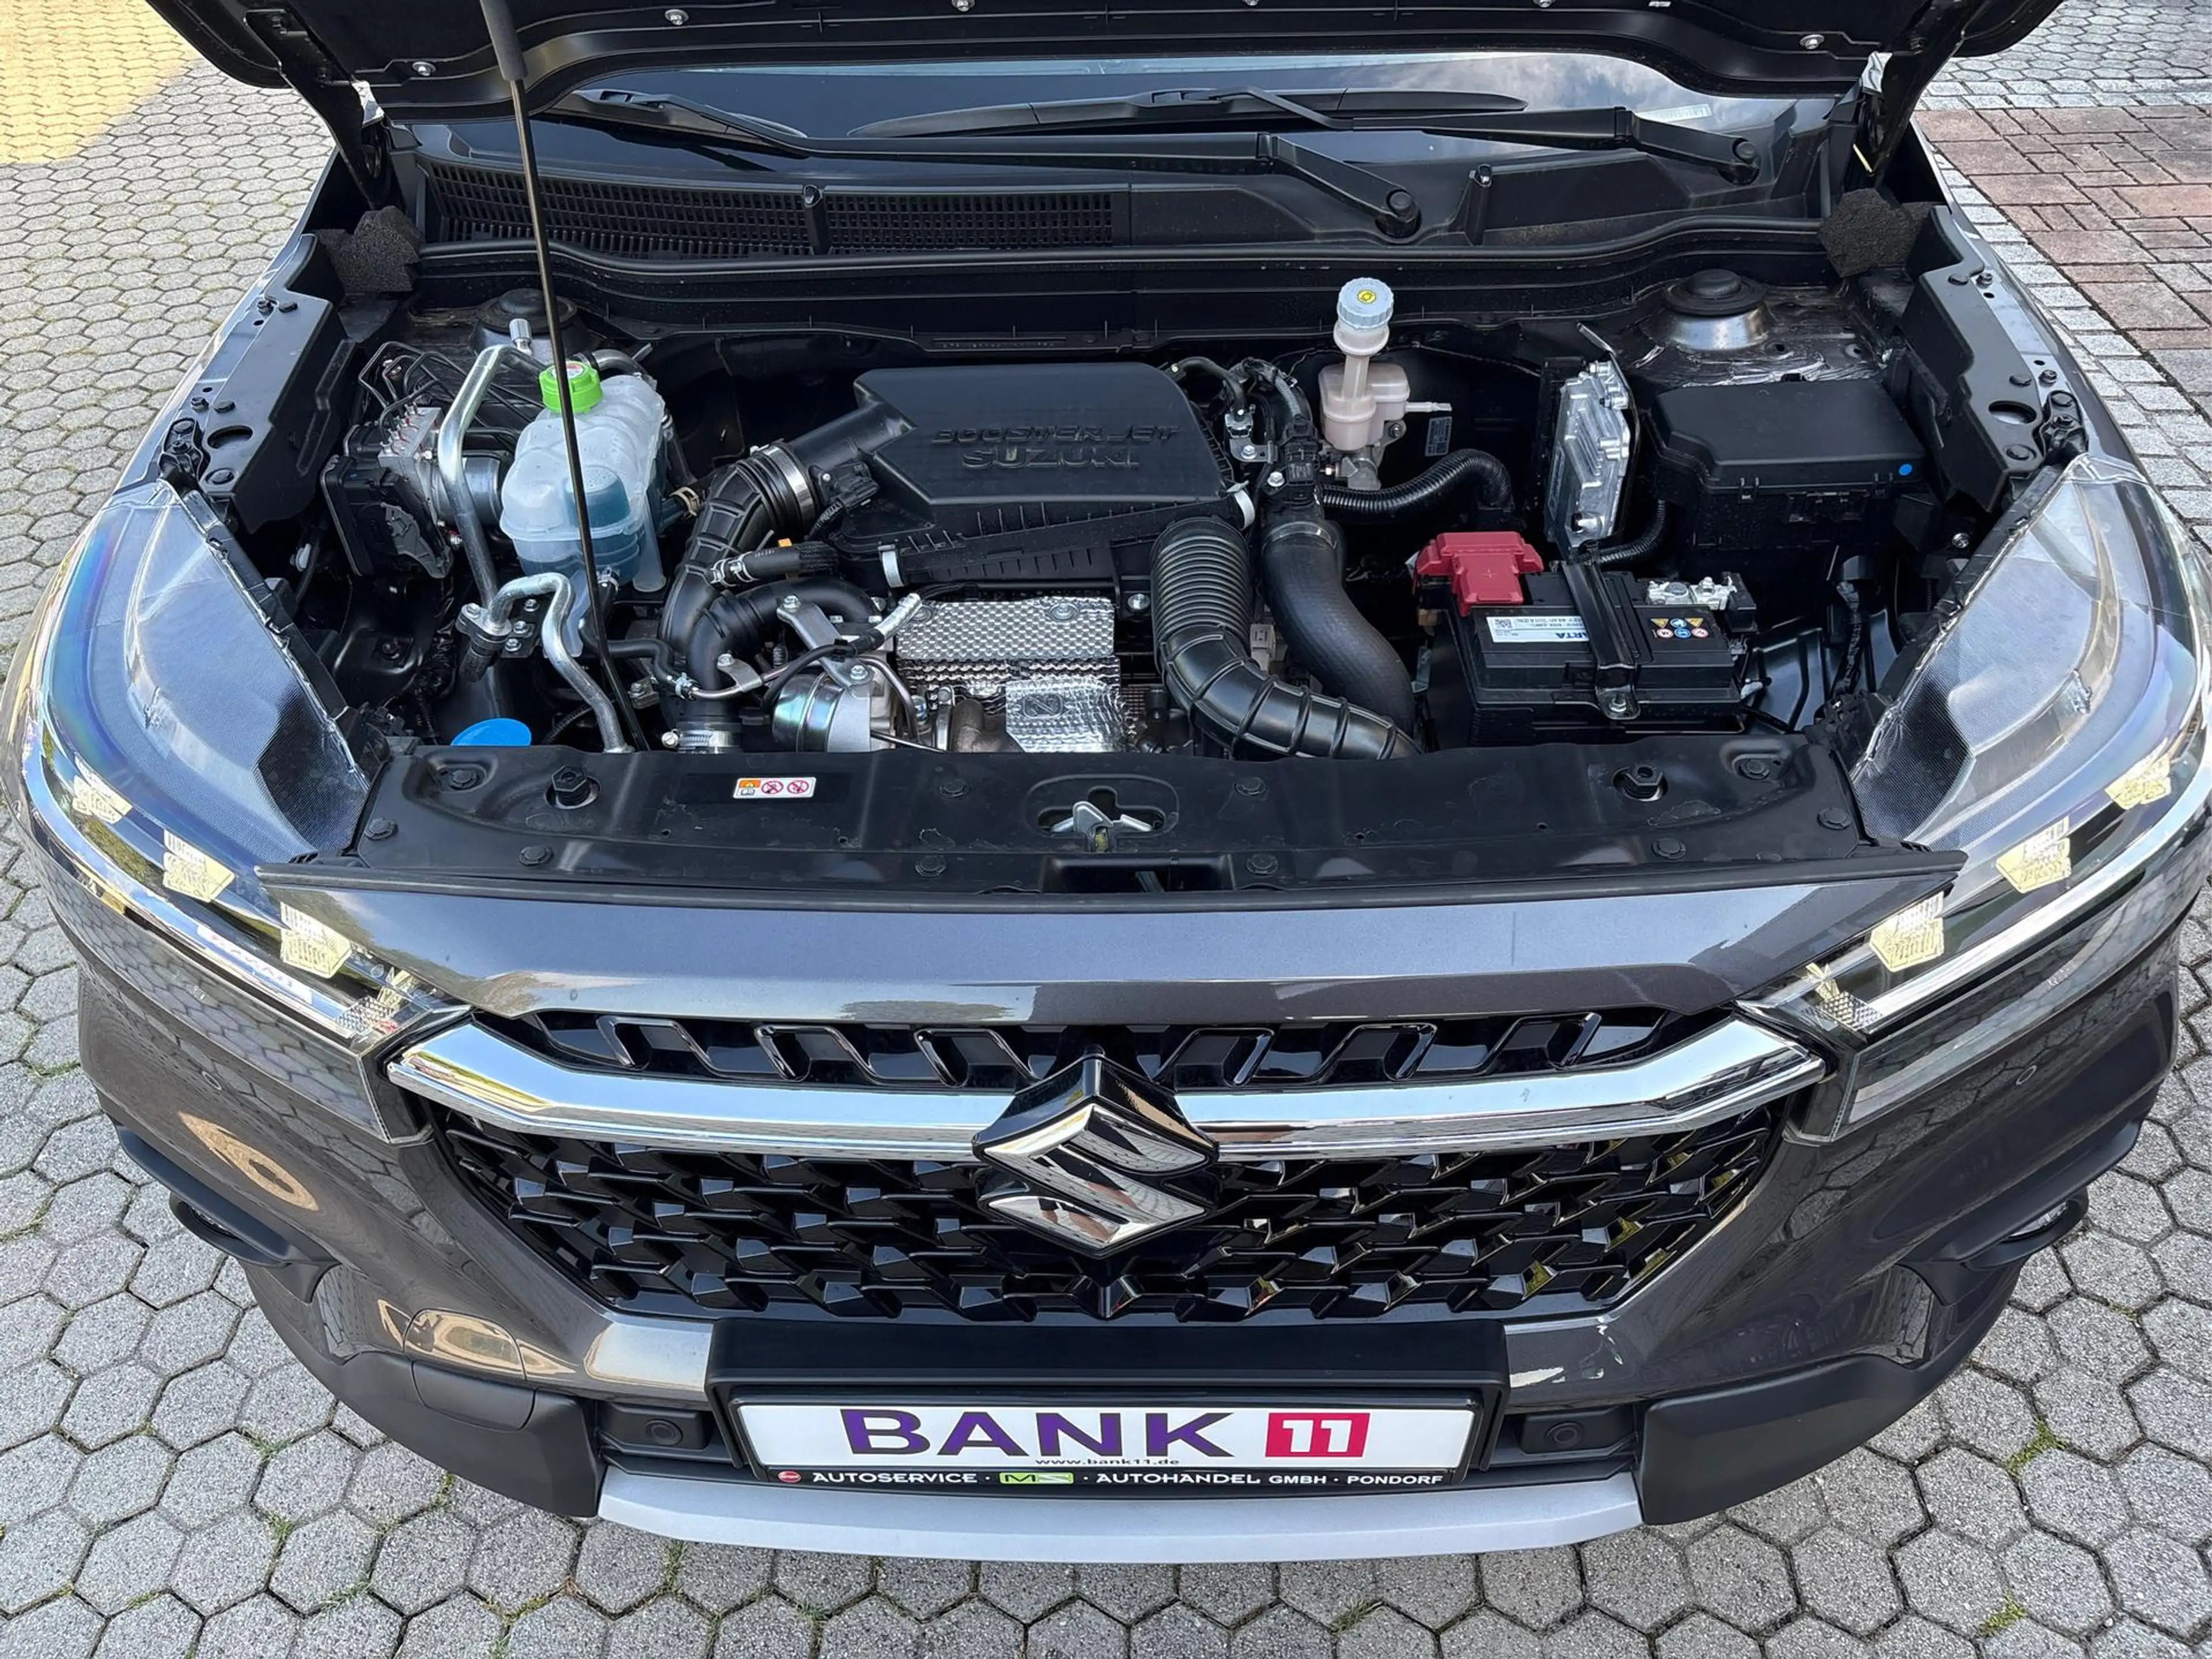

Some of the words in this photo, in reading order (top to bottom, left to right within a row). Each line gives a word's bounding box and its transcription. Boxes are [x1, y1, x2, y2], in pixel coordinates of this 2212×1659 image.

[961, 445, 1140, 469] SUZUKI
[840, 1409, 1234, 1456] BANK
[1282, 1419, 1352, 1453] 11
[813, 1472, 978, 1483] AUTOSERVICE
[1096, 1473, 1261, 1484] AUTOHANDEL
[1268, 1475, 1327, 1484] GMBH
[1347, 1475, 1444, 1484] PONDORF
